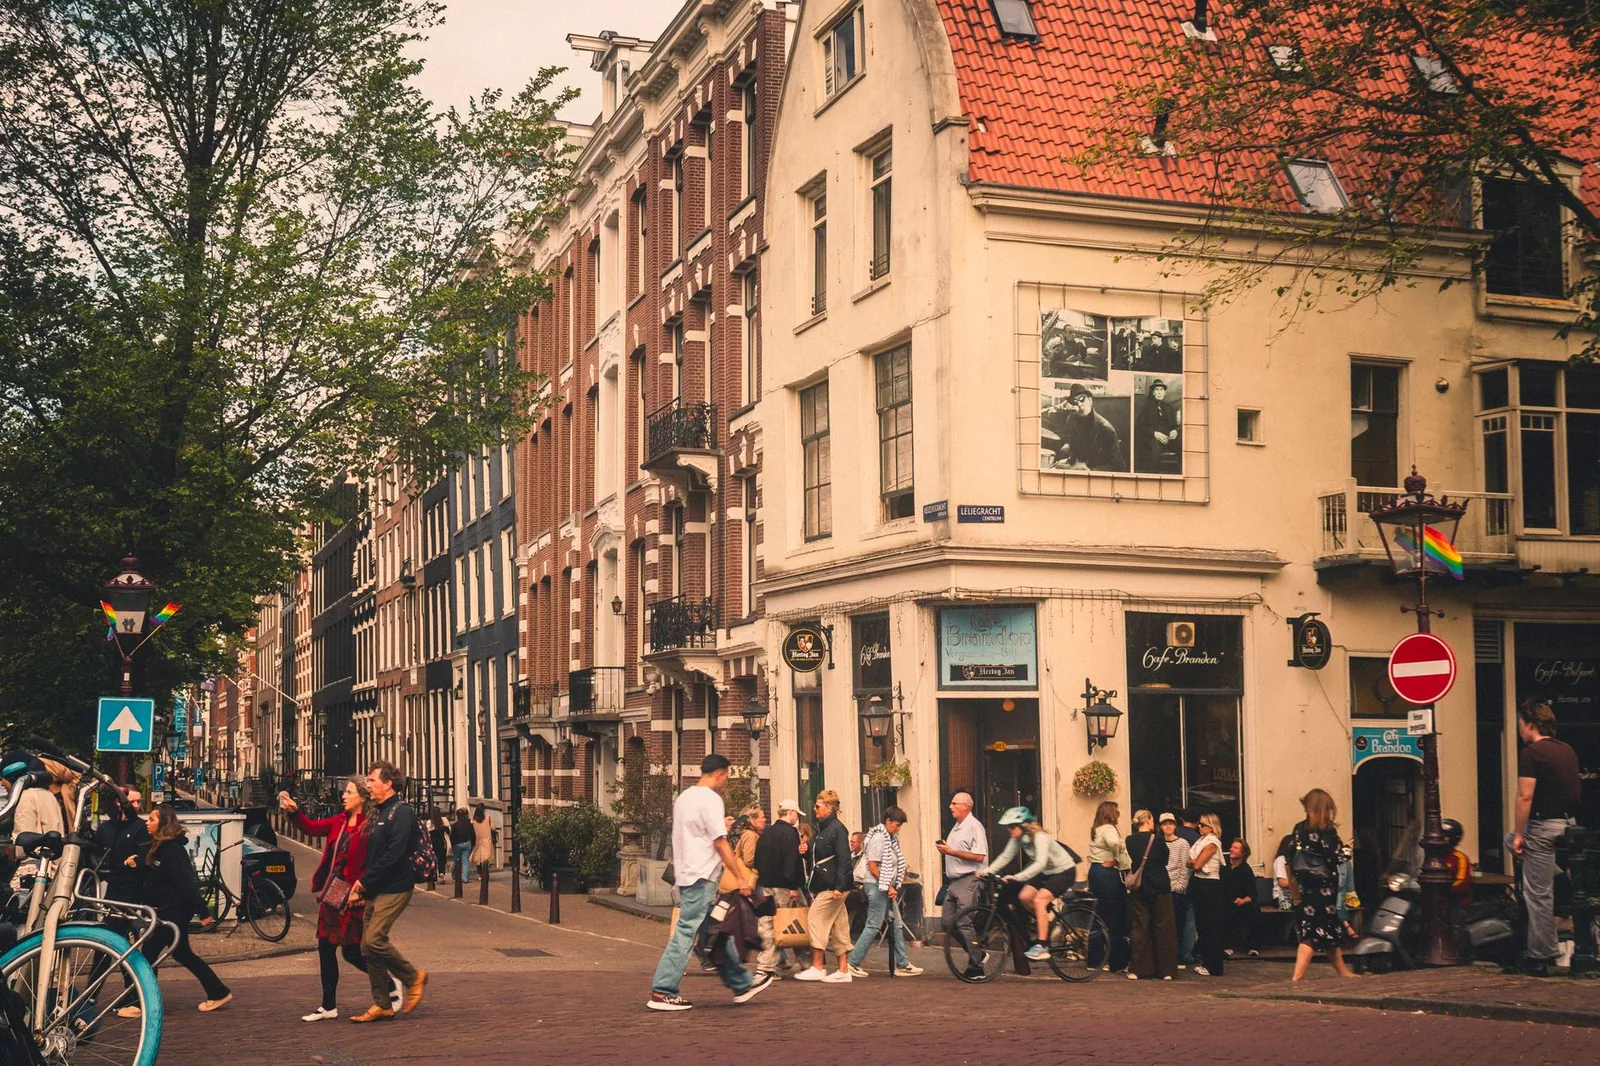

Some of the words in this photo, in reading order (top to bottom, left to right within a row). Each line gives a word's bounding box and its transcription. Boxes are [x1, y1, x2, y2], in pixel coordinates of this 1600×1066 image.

[960, 507, 1001, 515] LELIEGRACHT
[946, 624, 1032, 647] Brandon
[979, 667, 1001, 676] Hertog
[1003, 667, 1015, 675] Jan
[1371, 739, 1412, 754] Brandon
[155, 766, 162, 779] P
[196, 770, 202, 779] P
